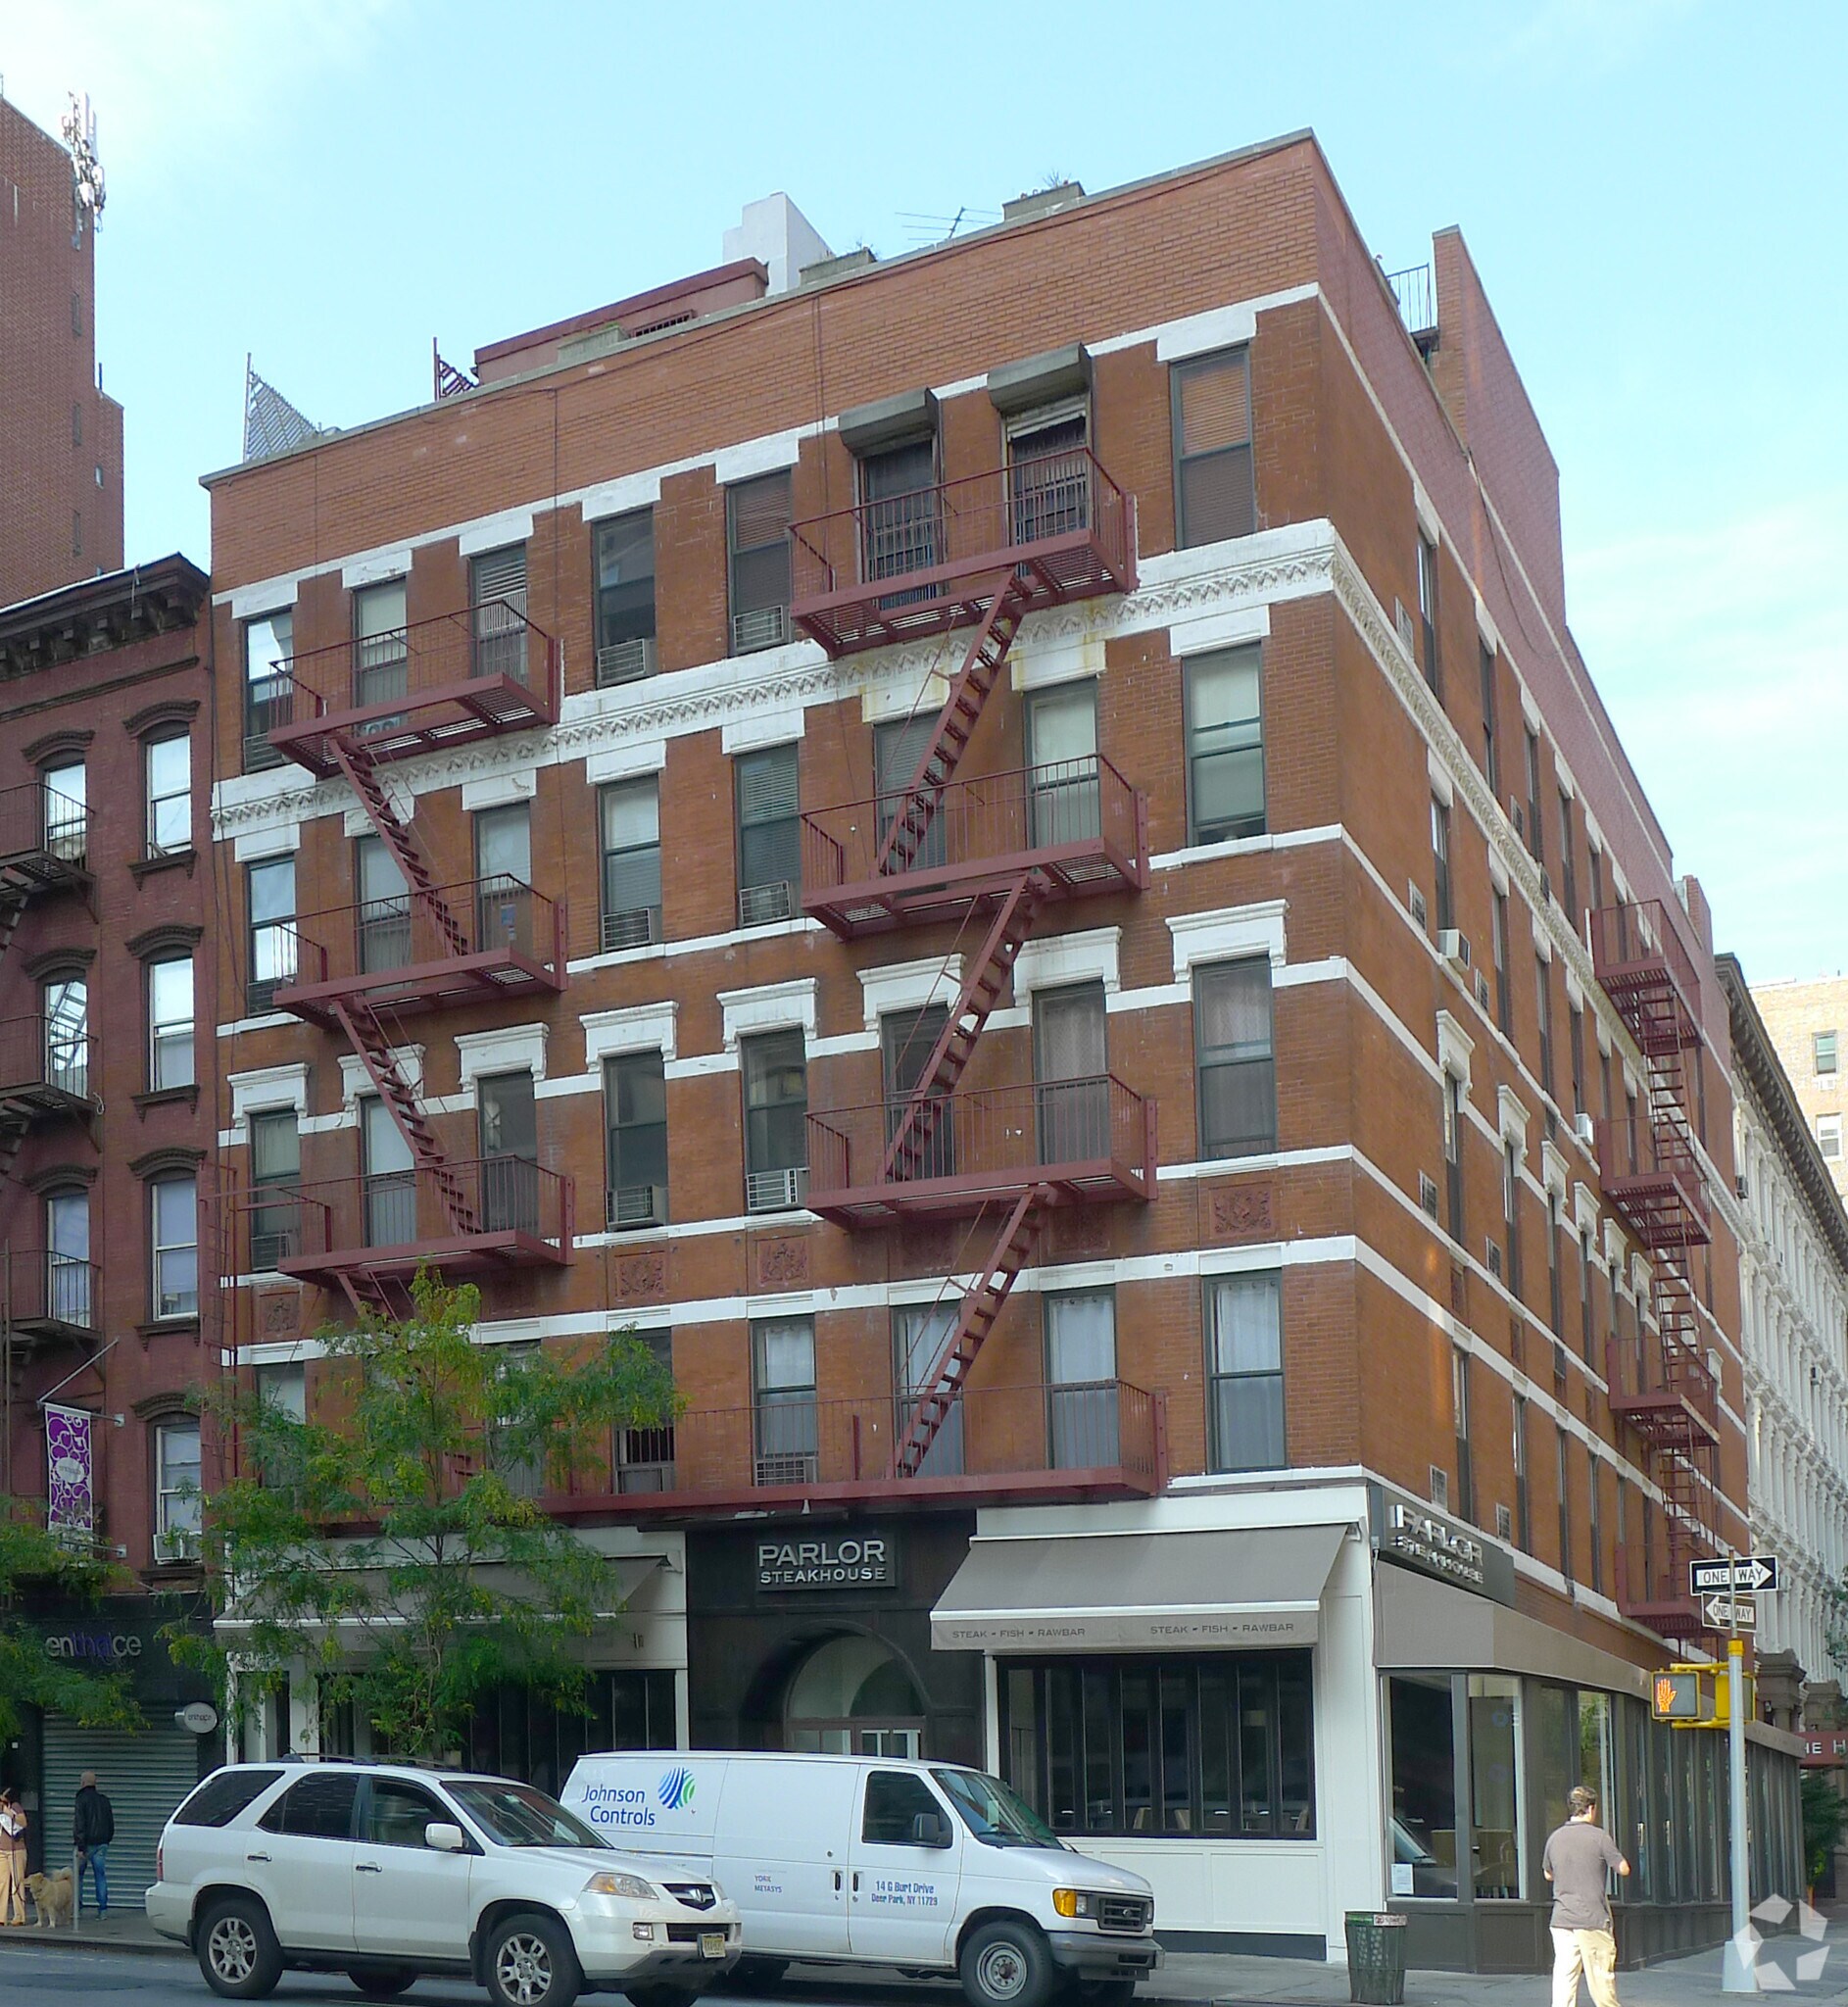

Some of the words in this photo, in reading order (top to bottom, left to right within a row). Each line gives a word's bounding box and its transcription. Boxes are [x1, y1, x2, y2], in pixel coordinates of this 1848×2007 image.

[1389, 1504, 1483, 1567] PARLOR
[758, 1540, 886, 1567] PARLOR
[760, 1568, 886, 1584] STEAKHOUSE
[1703, 1570, 1727, 1584] ONE
[1737, 1568, 1764, 1582] WAY
[1713, 1603, 1728, 1618] ONE
[951, 1630, 988, 1639] STEAK
[1038, 1628, 1086, 1637] RAWBAR
[1150, 1626, 1189, 1635] STEAK
[1201, 1625, 1229, 1634] FISH
[1242, 1623, 1294, 1633] RAWBAR
[581, 1784, 646, 1803] Johnson
[590, 1805, 656, 1826] Controls
[876, 1880, 886, 1891] 14
[895, 1882, 912, 1893] Burt
[913, 1883, 935, 1894] Drive
[871, 1893, 887, 1903] Deer
[907, 1895, 916, 1904] NY
